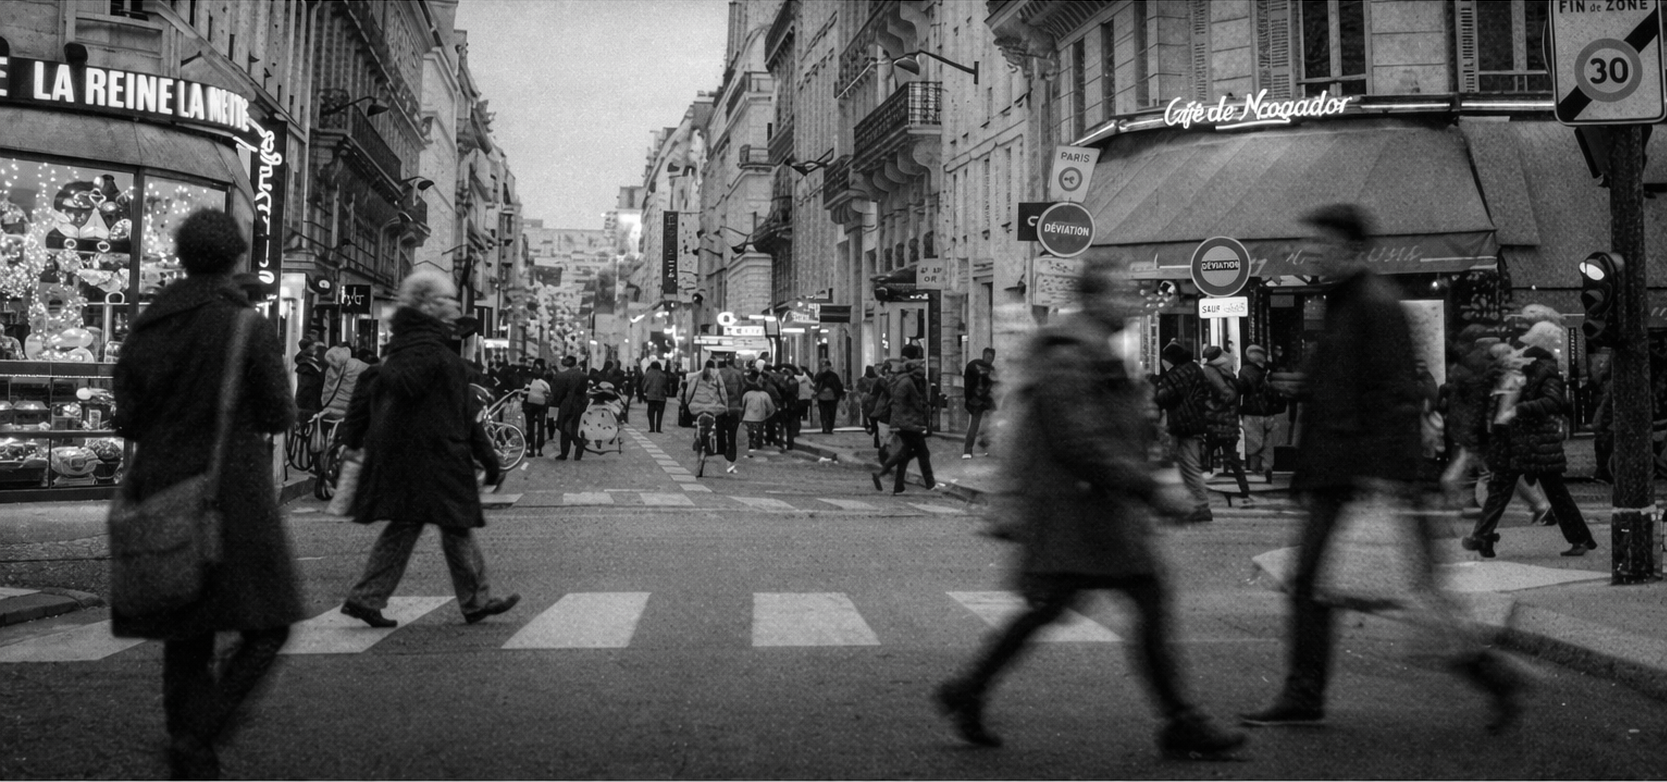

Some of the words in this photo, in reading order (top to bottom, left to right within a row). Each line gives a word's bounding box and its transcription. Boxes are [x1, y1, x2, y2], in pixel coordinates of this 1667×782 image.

[1559, 0, 1585, 13] FIN
[1590, 3, 1601, 12] de
[1605, 0, 1648, 11] ZONE
[1590, 57, 1629, 84] 30
[33, 61, 75, 102] LA
[85, 67, 174, 115] REINE
[176, 80, 205, 120] LA
[1207, 95, 1235, 122] de
[1060, 151, 1090, 163] PARIS
[1044, 221, 1090, 237] DÉVIATION
